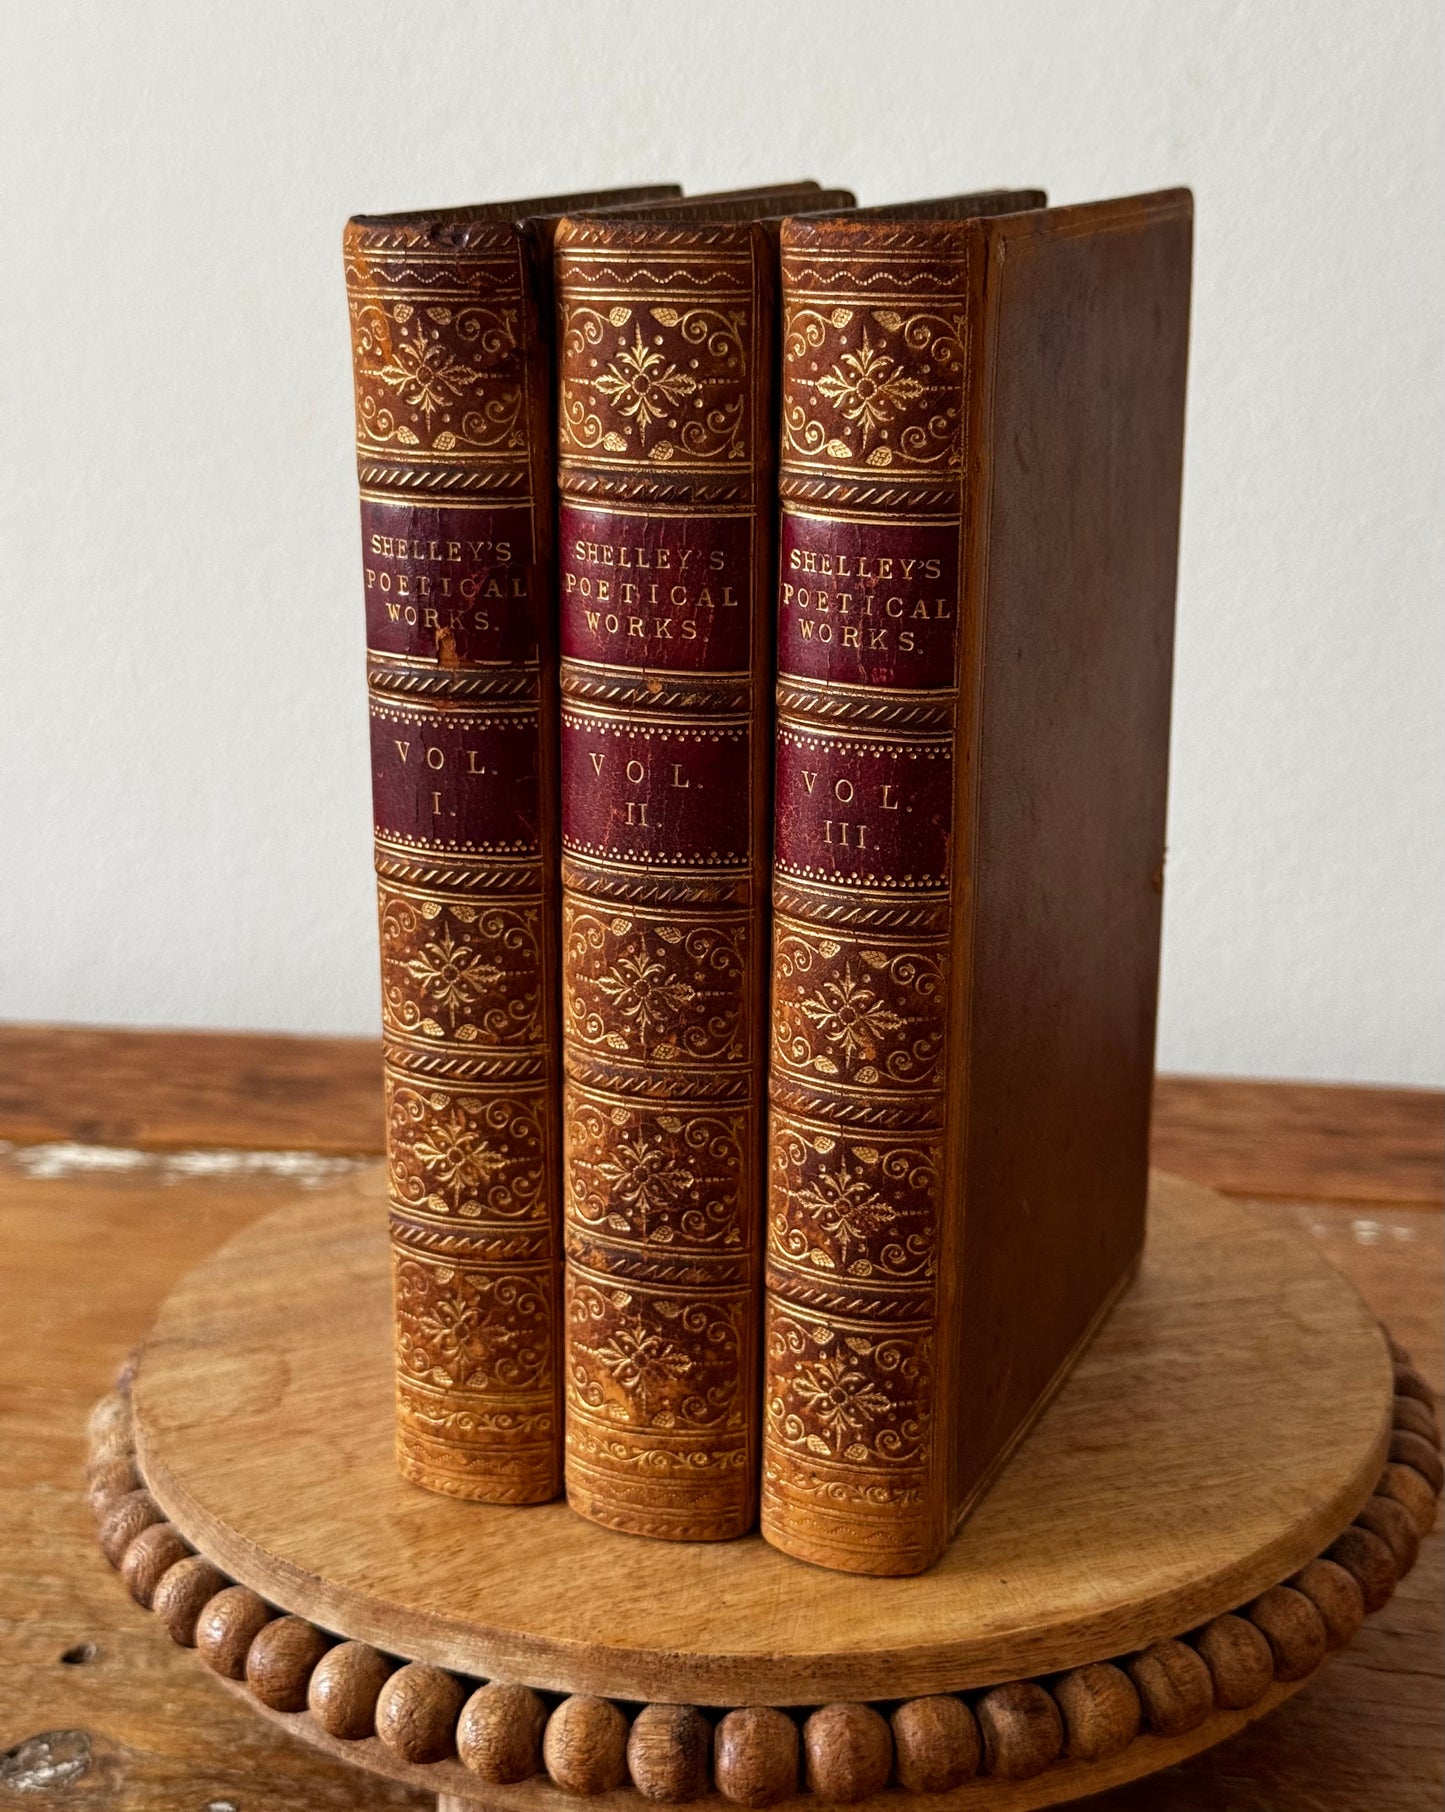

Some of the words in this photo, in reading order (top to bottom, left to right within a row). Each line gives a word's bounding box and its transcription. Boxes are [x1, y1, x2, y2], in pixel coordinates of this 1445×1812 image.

[371, 534, 512, 562] SHELLEY'S
[790, 549, 941, 580] SHELLEY'S
[366, 569, 527, 598] POETICAL
[566, 573, 738, 608] POETICAL
[386, 602, 500, 631] WORKS.
[783, 583, 950, 619] POETICAL
[585, 610, 709, 642] WORKS.
[799, 618, 923, 654] WORKS.
[395, 740, 498, 775] VOL.
[589, 753, 703, 789] VOL.
[432, 792, 456, 816] I.
[802, 771, 912, 812] VOL.
[625, 802, 663, 828] II.
[823, 820, 880, 850] III.
